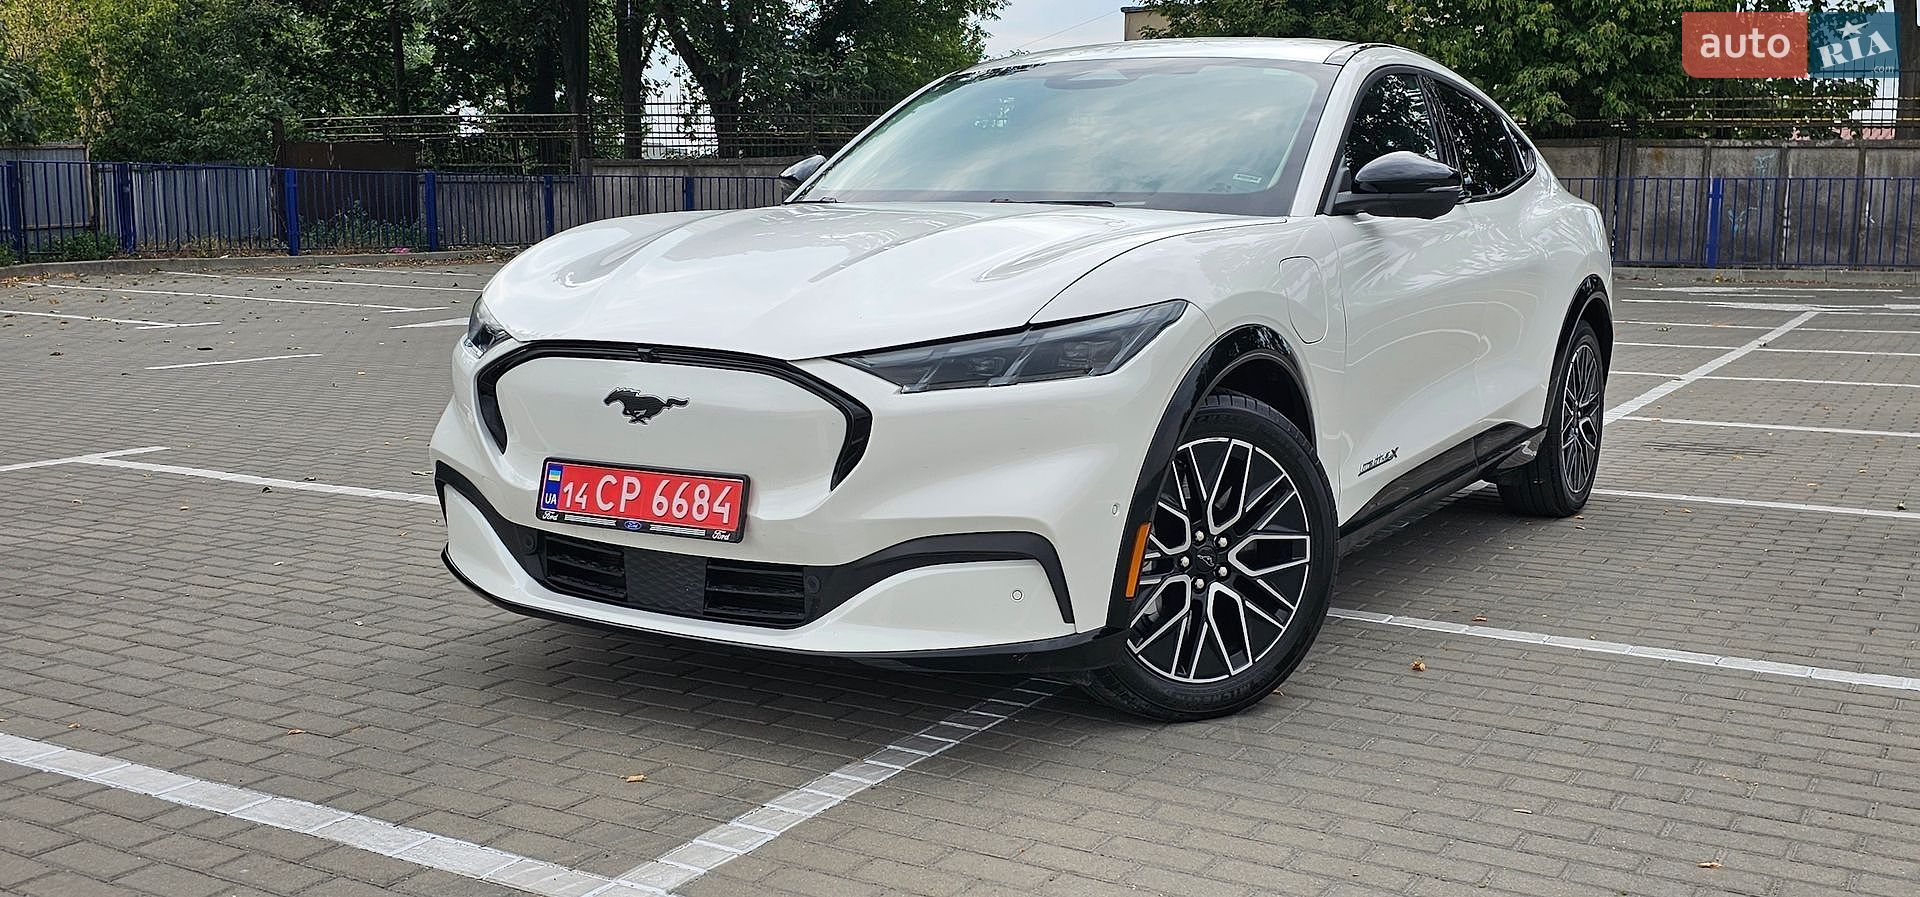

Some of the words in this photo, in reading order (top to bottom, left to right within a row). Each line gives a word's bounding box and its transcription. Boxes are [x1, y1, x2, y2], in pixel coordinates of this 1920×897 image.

[545, 493, 557, 506] UA
[563, 481, 589, 510] 14
[595, 474, 642, 513] CP
[651, 479, 733, 524] 6684
[542, 511, 559, 520] Ford
[712, 529, 731, 541] Ford
